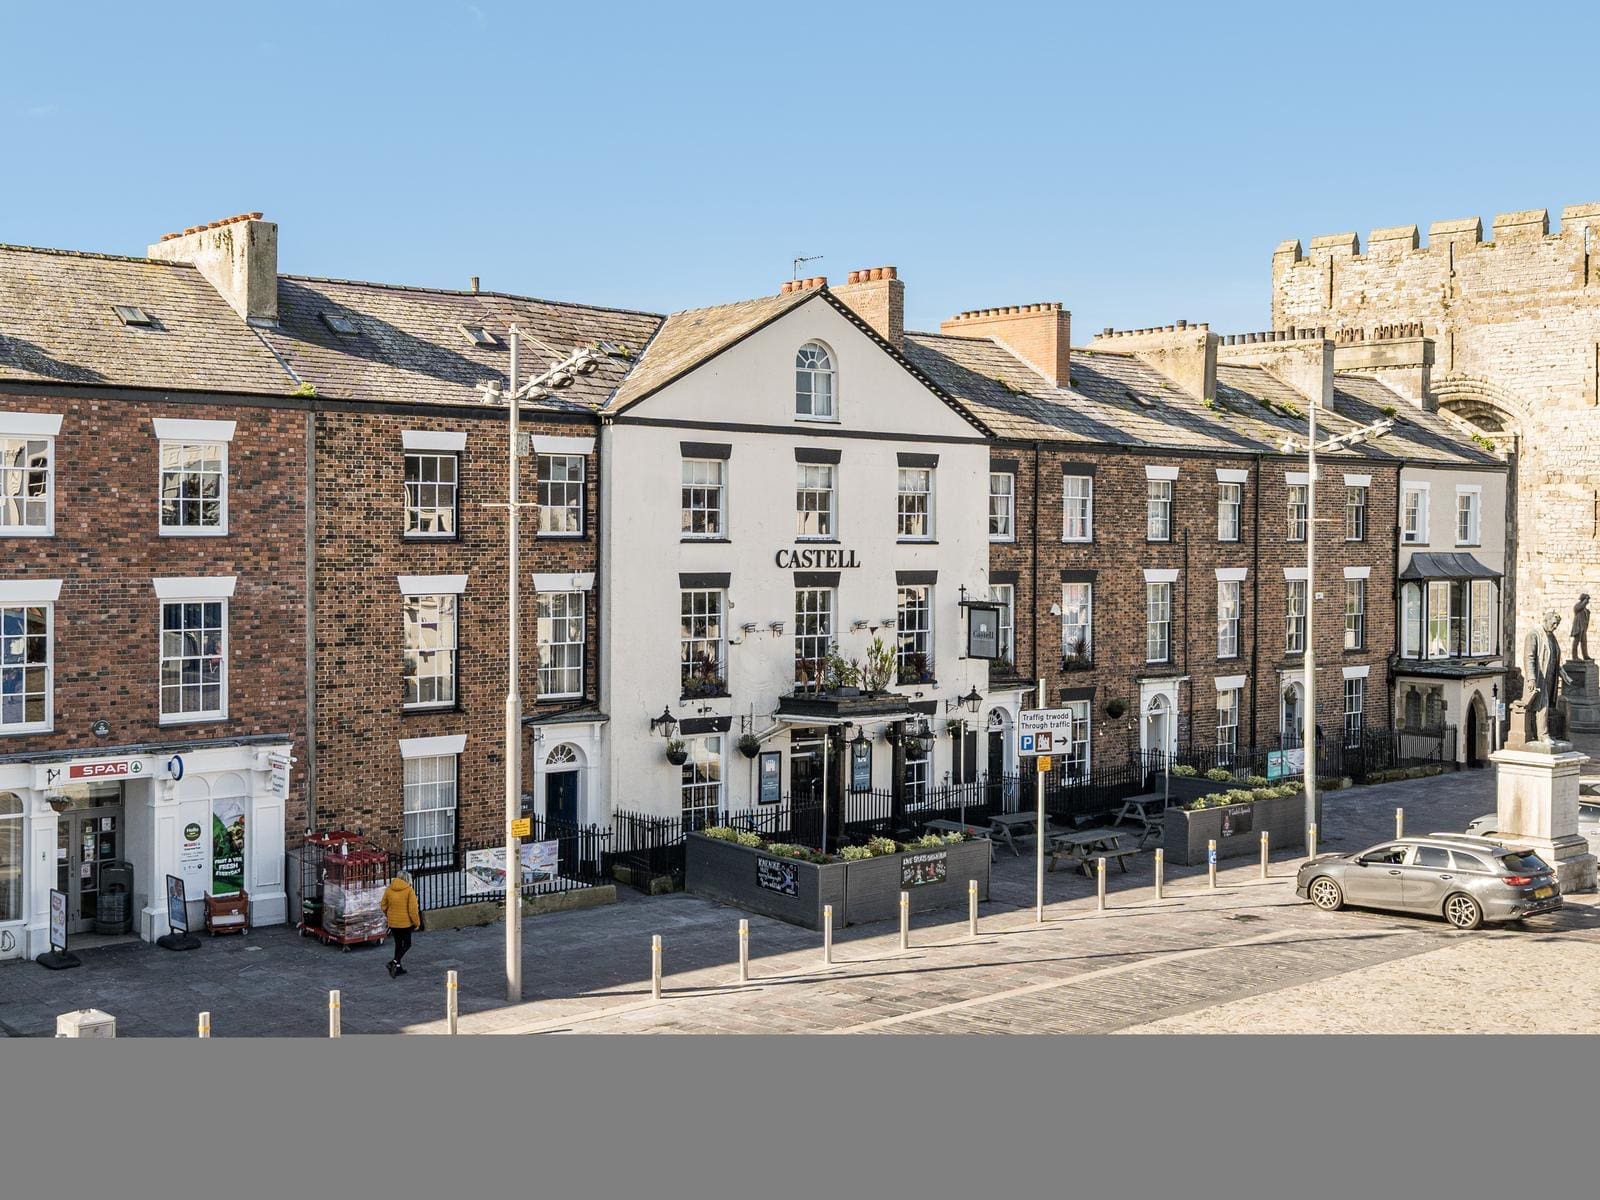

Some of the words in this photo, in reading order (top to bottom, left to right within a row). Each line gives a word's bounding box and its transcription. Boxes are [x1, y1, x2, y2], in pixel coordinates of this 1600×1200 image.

[775, 549, 861, 569] CASTELL
[1023, 736, 1032, 749] P
[83, 763, 128, 776] SPAR
[218, 862, 239, 870] FRESH
